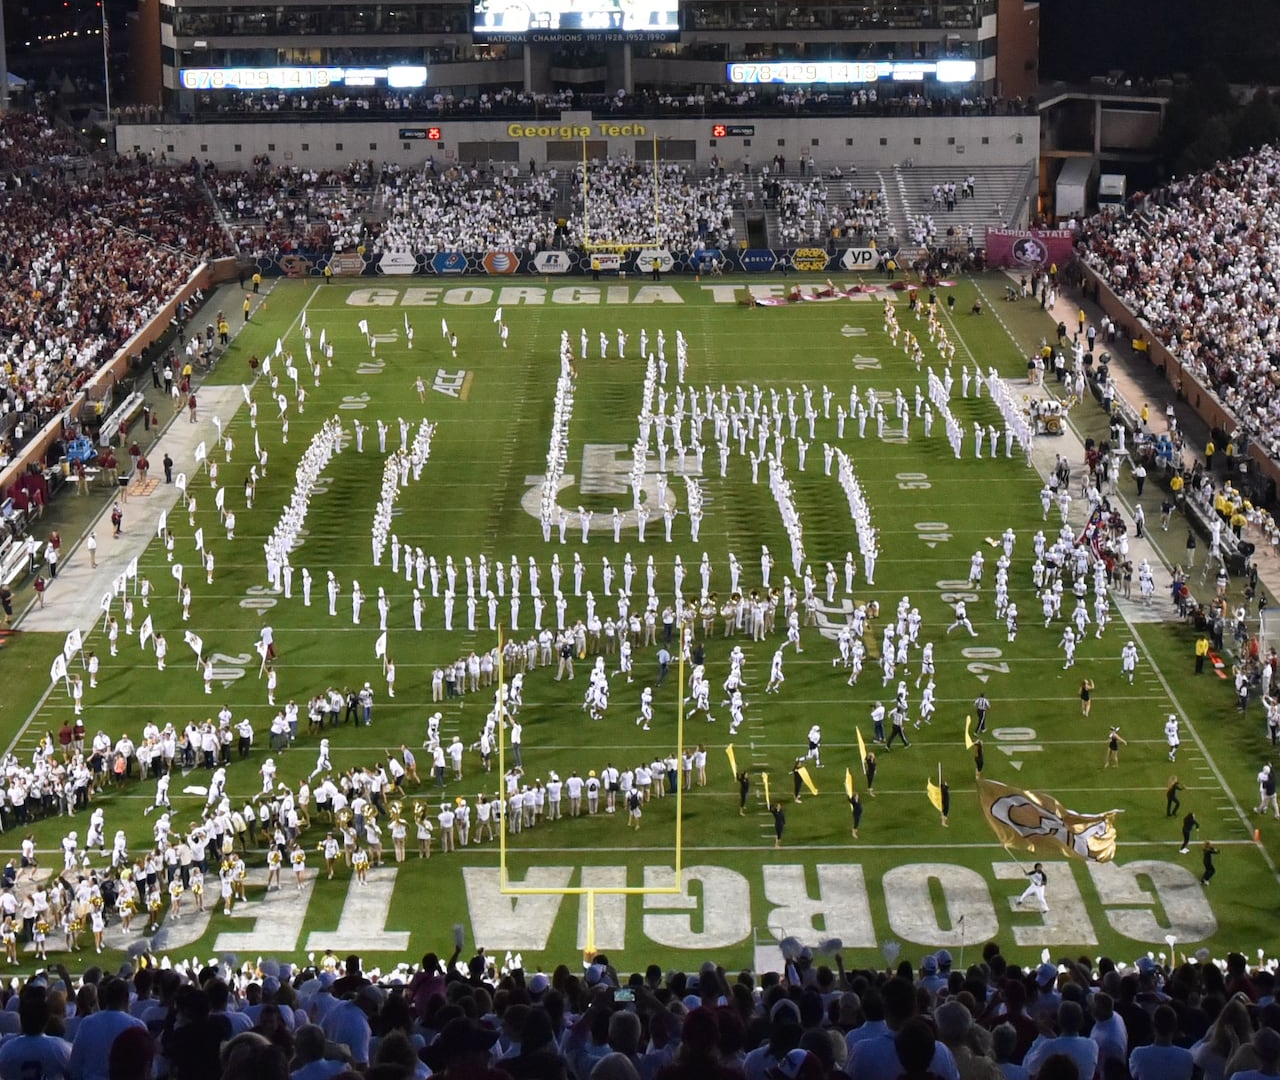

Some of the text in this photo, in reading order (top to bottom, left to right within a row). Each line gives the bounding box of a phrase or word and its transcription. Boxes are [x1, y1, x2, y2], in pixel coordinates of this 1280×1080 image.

[487, 34, 528, 43] NATIONAL
[532, 33, 583, 42] CHAMPIONS
[647, 32, 666, 41] 1990
[428, 127, 440, 139] 25
[507, 123, 646, 138] Georgia Tech
[713, 125, 726, 137] 25
[987, 227, 1071, 239] FLORIDA STATE
[851, 250, 873, 265] yp
[345, 285, 685, 306] GEORGIA
[431, 367, 466, 399] ACC
[895, 472, 933, 490] 50
[913, 521, 955, 542] 40
[934, 578, 981, 603] 30
[960, 646, 1011, 674] 20
[991, 726, 1044, 757] 10
[462, 859, 1218, 950] GEORGIA
